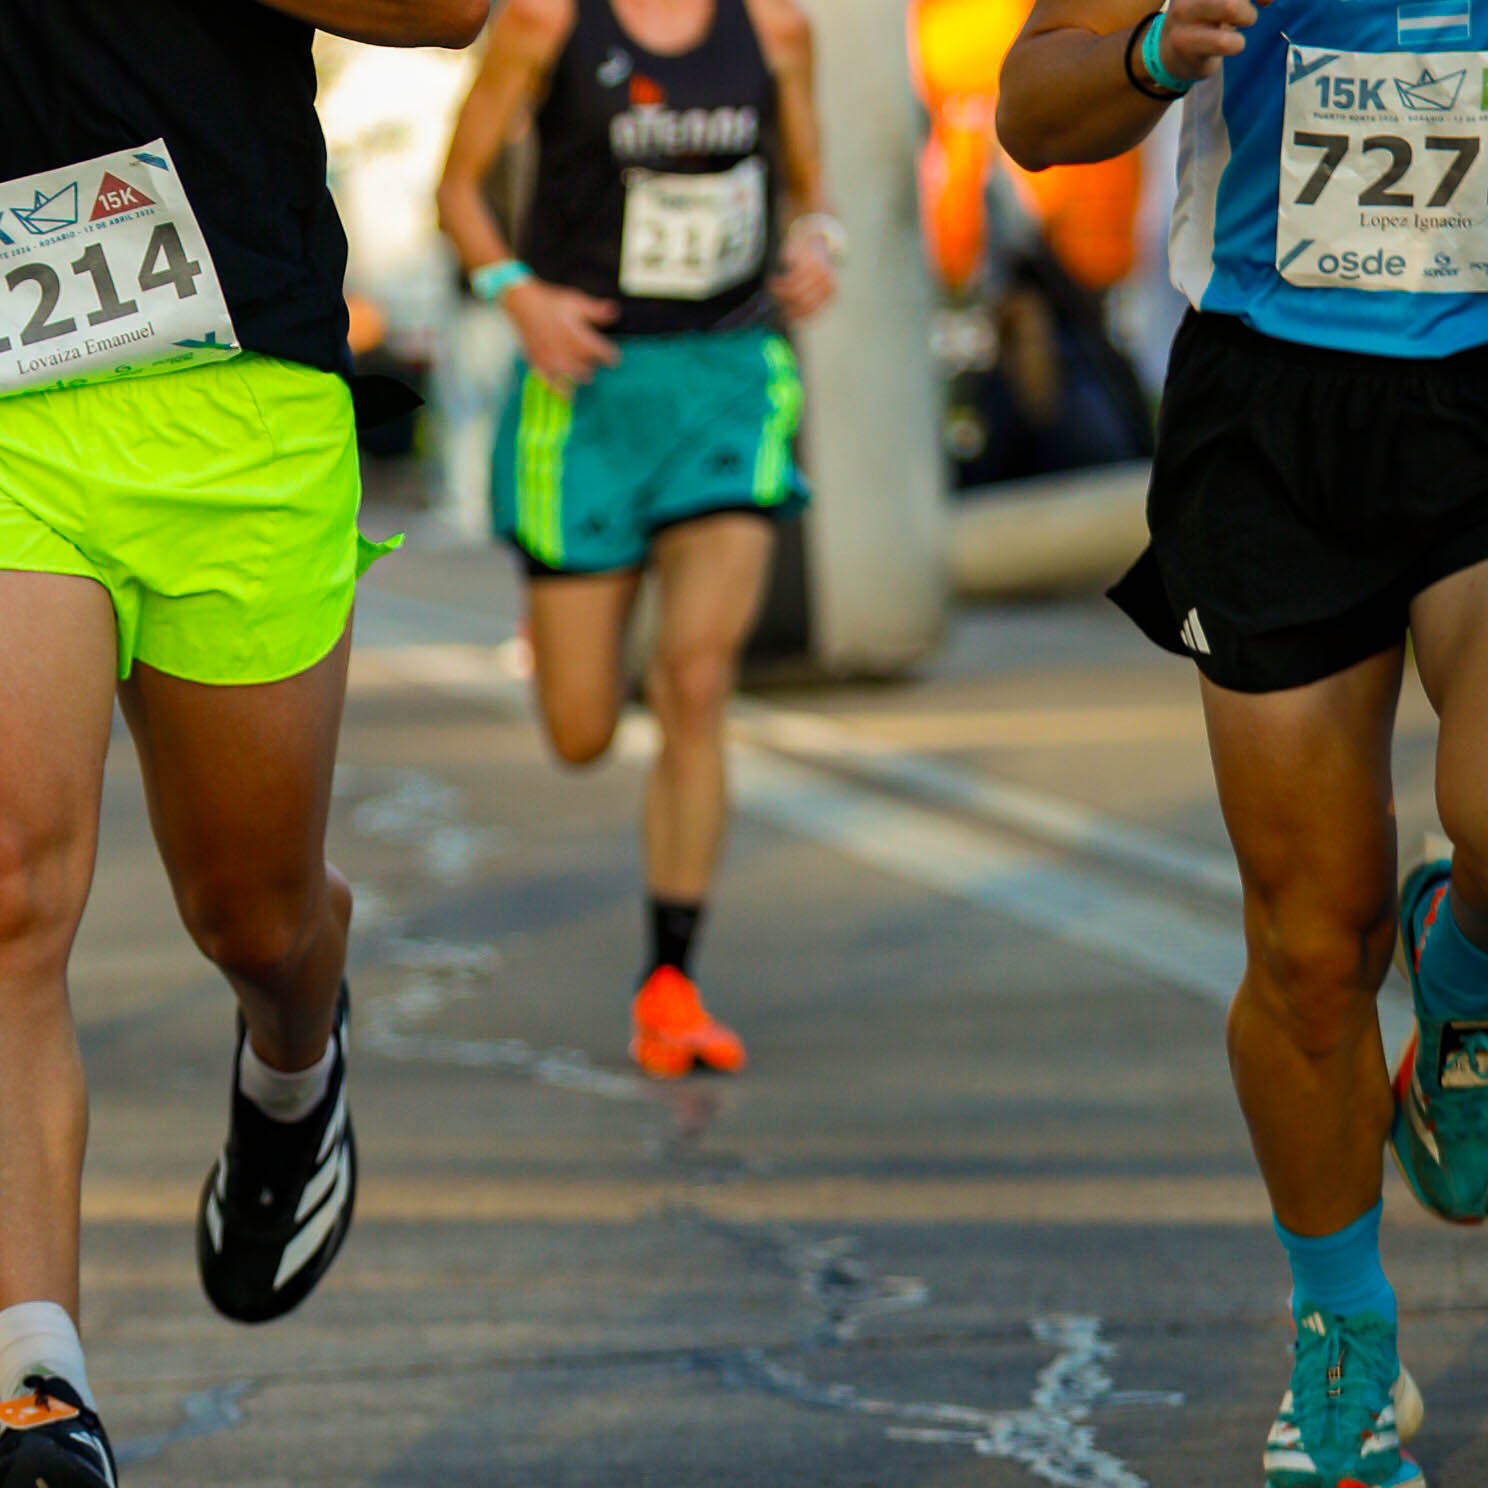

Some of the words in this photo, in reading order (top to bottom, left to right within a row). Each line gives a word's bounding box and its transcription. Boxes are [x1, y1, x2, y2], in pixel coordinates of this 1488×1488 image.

[1315, 75, 1387, 111] 15K
[1293, 130, 1488, 209] 727
[98, 185, 140, 212] 15K
[1360, 212, 1408, 231] Lopez
[1414, 213, 1473, 231] Ignacio
[1317, 248, 1407, 279] osde
[16, 347, 81, 375] Lovaiza
[84, 321, 156, 356] Emanuel
